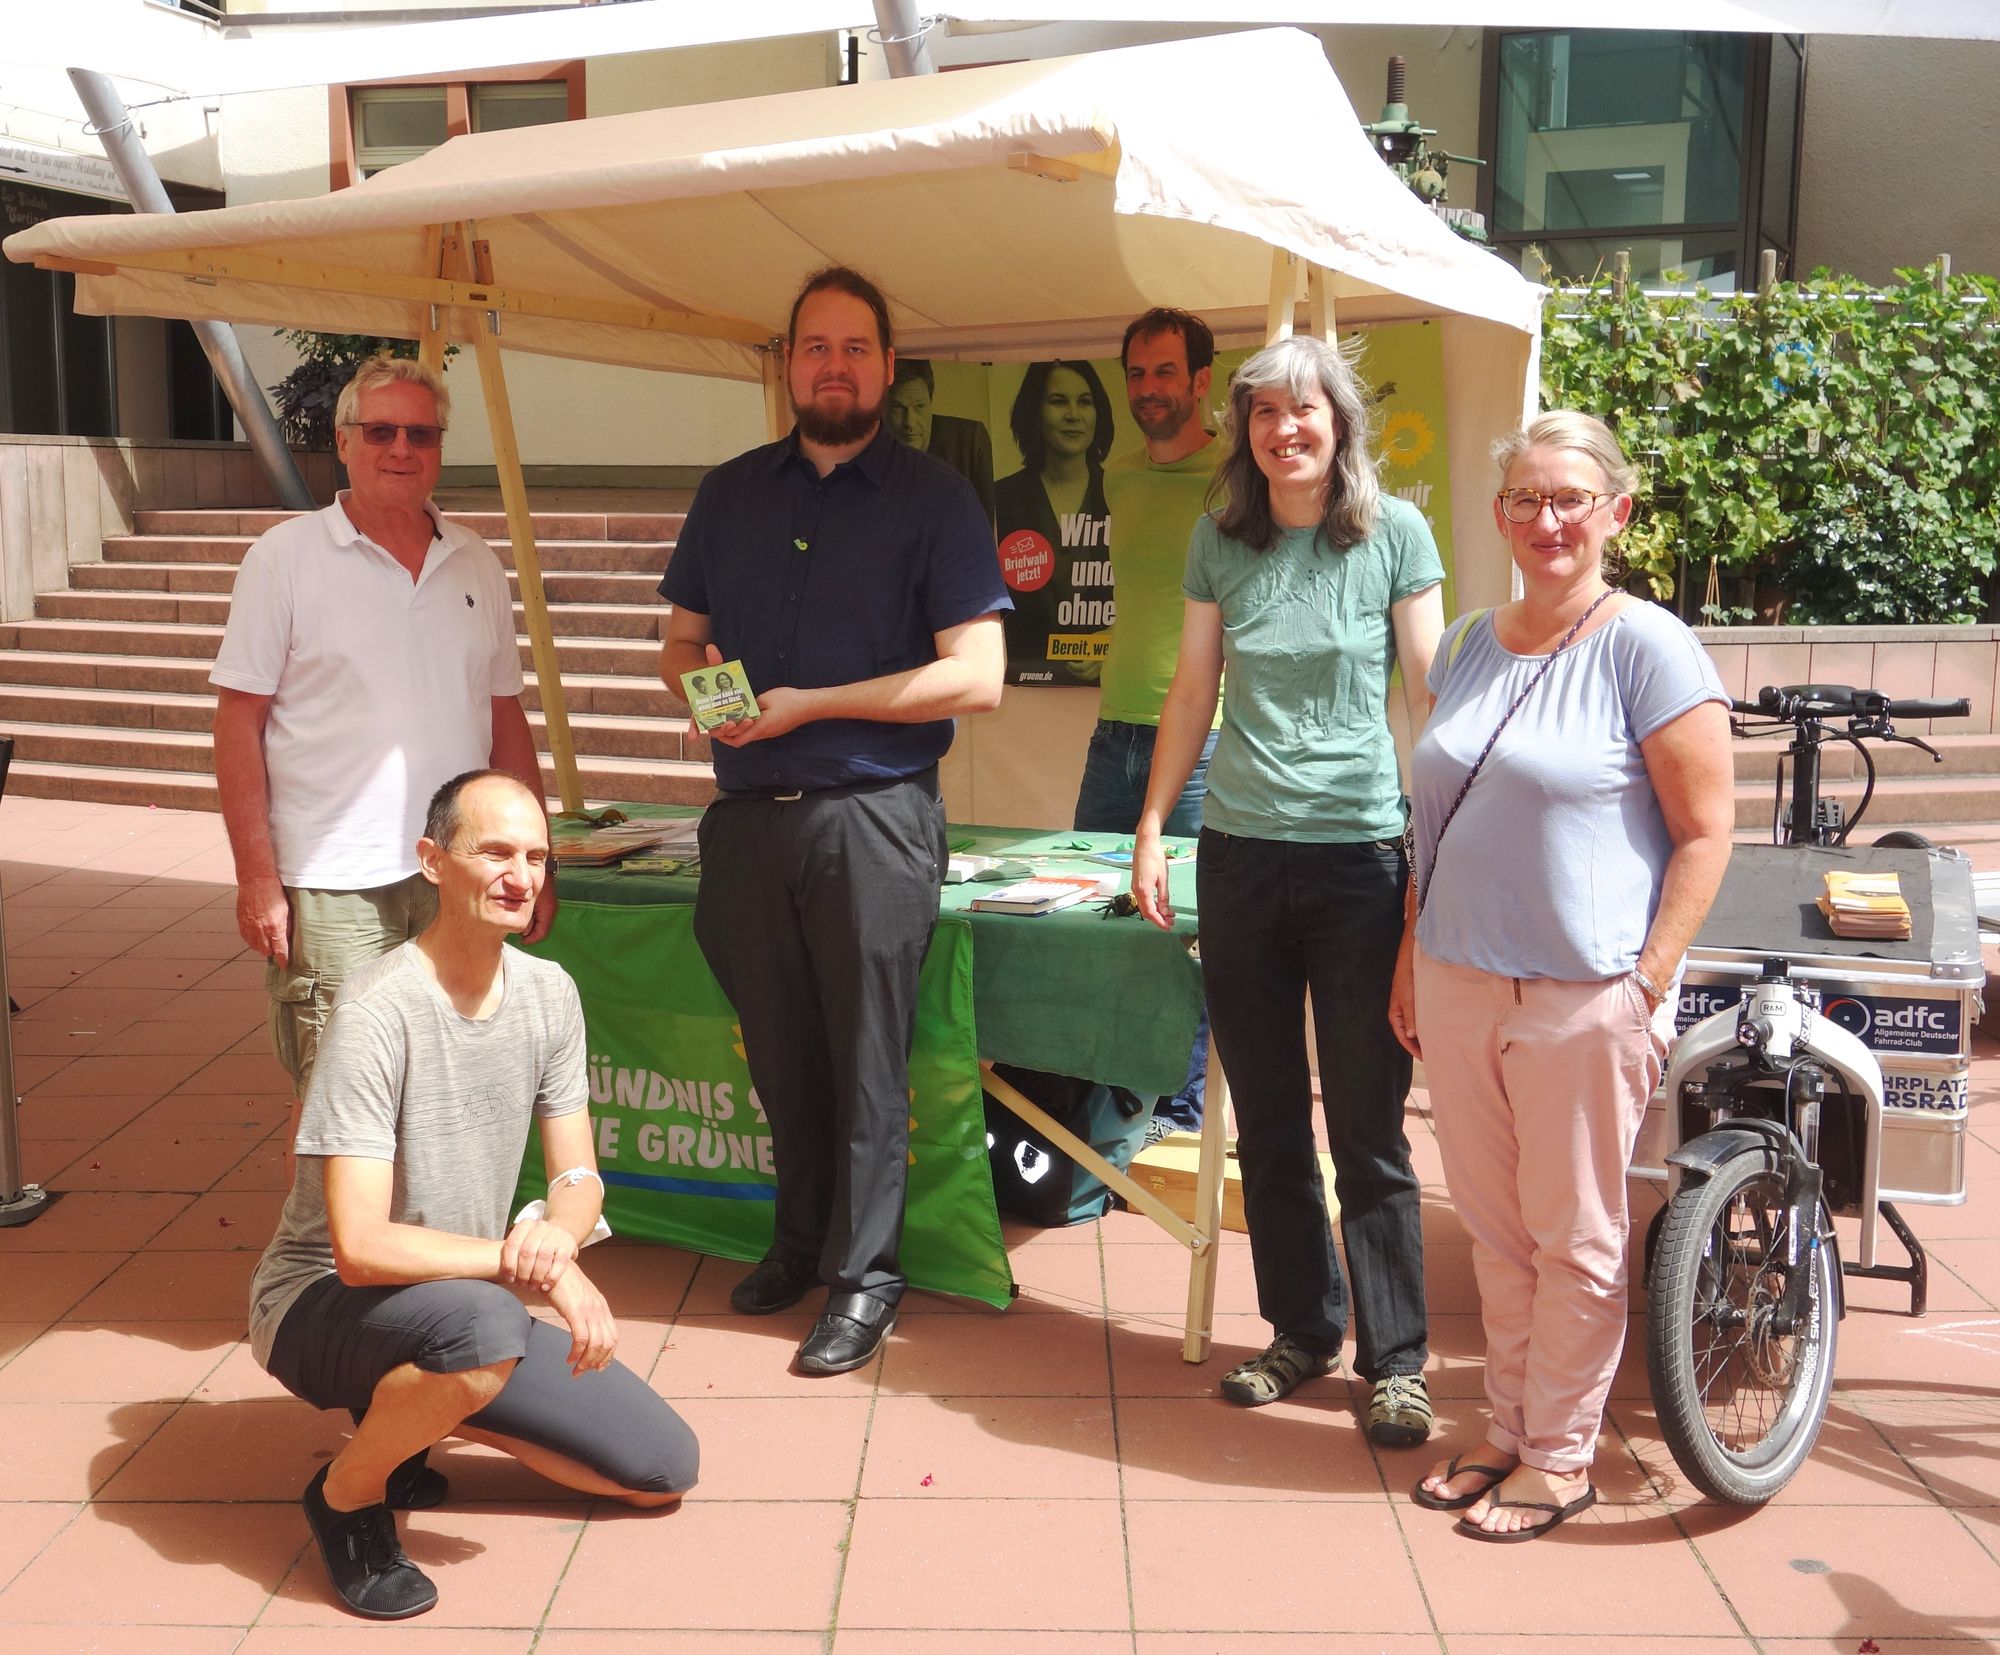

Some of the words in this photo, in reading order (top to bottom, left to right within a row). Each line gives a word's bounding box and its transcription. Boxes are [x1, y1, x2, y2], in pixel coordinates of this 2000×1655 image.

[1061, 513, 1111, 546] Wirt
[1004, 550, 1048, 571] Briefwahl
[1017, 566, 1041, 585] jetzt!
[1058, 593, 1116, 626] ohne
[1051, 639, 1091, 657] Bereit,
[1093, 643, 1109, 655] we
[1019, 671, 1053, 681] gruene.de
[1678, 992, 1725, 1015] dfc
[1763, 1004, 1783, 1013] R&M
[1874, 1006, 1945, 1030] adfc
[1874, 1028, 1919, 1038] Allgemeiner
[1920, 1030, 1959, 1040] Deutscher
[1874, 1037, 1923, 1047] Fahrrad-Club
[589, 1054, 735, 1120] ÜNDNIS
[1882, 1076, 1968, 1092] HRPLATZ
[1884, 1091, 1968, 1110] RSRAD
[638, 1119, 776, 1175] GRÜNE
